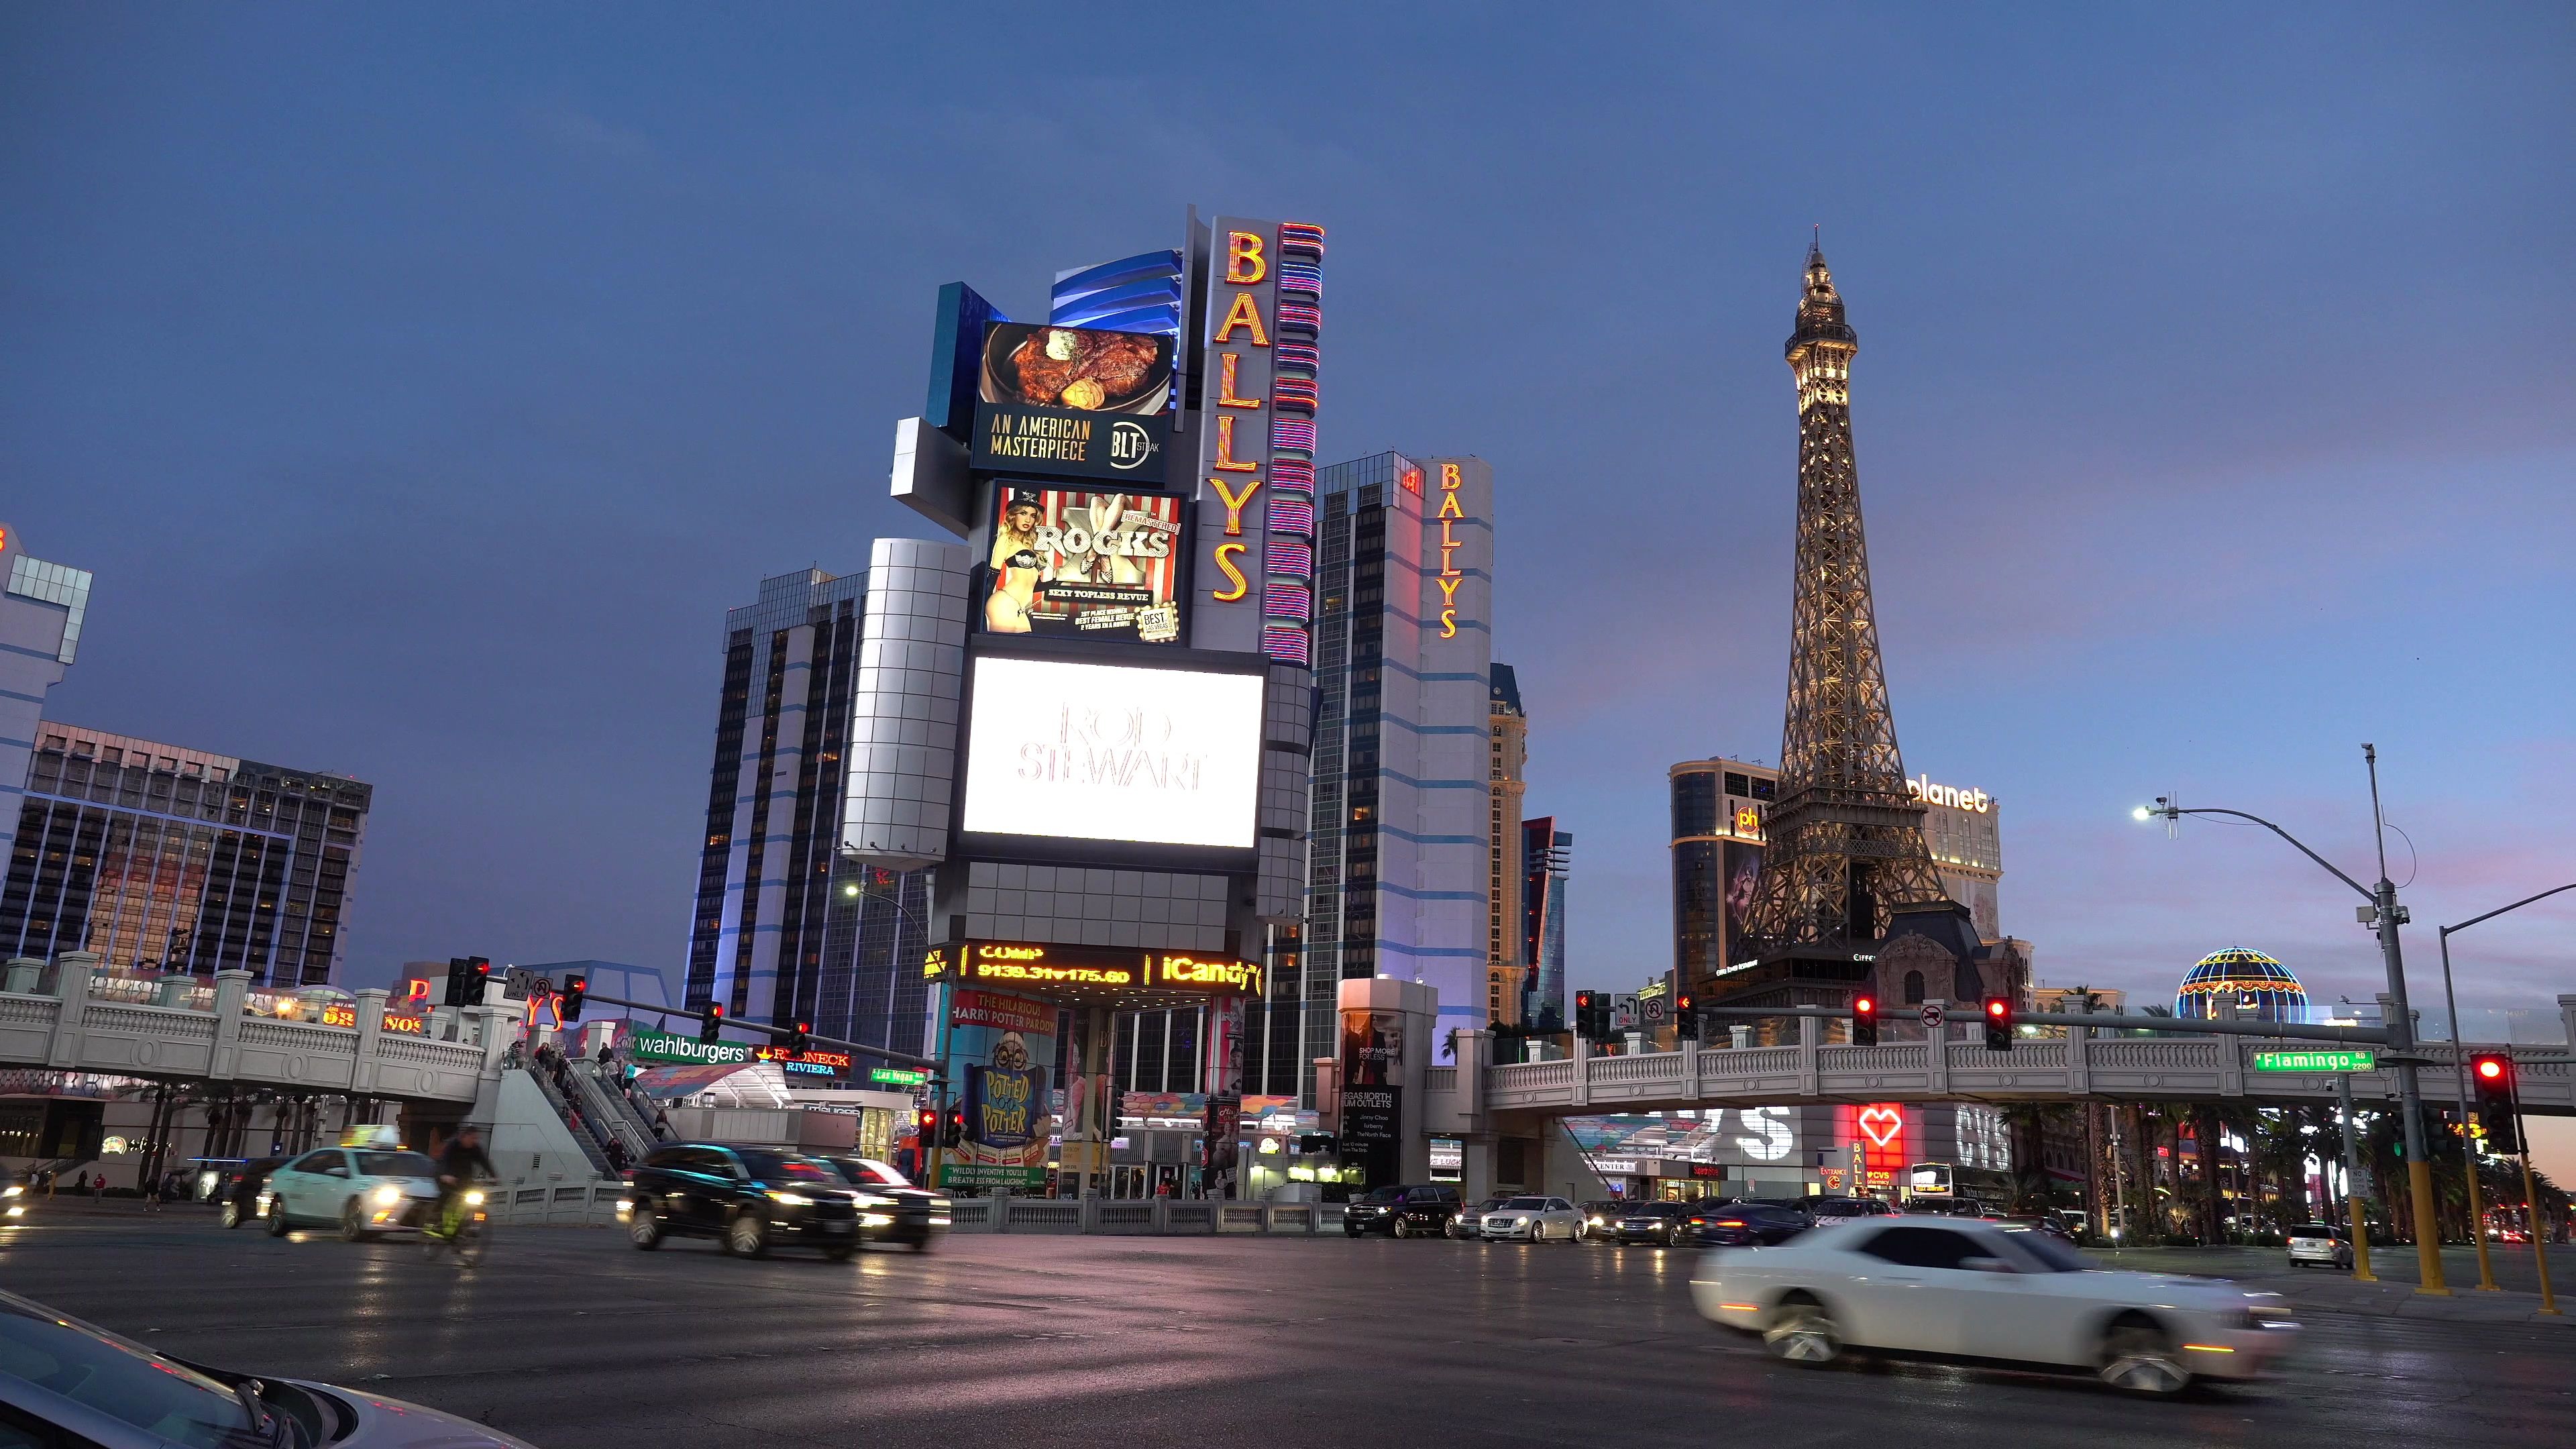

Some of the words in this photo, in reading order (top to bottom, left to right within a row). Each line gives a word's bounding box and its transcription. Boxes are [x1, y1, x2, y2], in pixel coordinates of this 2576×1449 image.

[991, 413, 1012, 433] AN
[1018, 415, 1091, 440] AMERICAN
[991, 435, 1086, 461] MASTERPIECE
[1111, 431, 1140, 458] BLT
[1136, 441, 1159, 452] STEAK
[1033, 526, 1170, 557] ROCKS
[1049, 589, 1073, 598] SEXY
[1073, 590, 1116, 600] TOPLESS
[1116, 591, 1149, 601] REVUE
[1075, 616, 1091, 625] BEST
[1091, 614, 1116, 623] FEMALE
[1085, 623, 1102, 631] YEARS
[1144, 612, 1165, 625] BEST
[1905, 773, 1988, 814] planet
[1739, 807, 1758, 828] ph
[1163, 956, 1248, 991] iCandy
[977, 994, 997, 1008] THE
[999, 998, 1041, 1017] HILARIOUS
[953, 1006, 991, 1022] HARRY
[991, 1011, 1024, 1028] POTTER
[1026, 1017, 1055, 1032] PARODY
[640, 1036, 745, 1064] wahlburgers
[774, 1049, 849, 1067] RNECK
[786, 1061, 835, 1075] RIVIERA
[2264, 1052, 2349, 1070] Flamingo
[877, 1069, 890, 1079] Las
[893, 1071, 914, 1084] Vegas
[984, 1071, 1029, 1104] POTTED
[1364, 1092, 1392, 1101] NORTH
[1357, 1100, 1393, 1108] OUTLETS
[981, 1104, 1026, 1140] POTTER
[977, 1168, 1005, 1176] INVENTIVE
[1821, 1167, 1847, 1175] ENTRANCE
[1874, 1171, 1890, 1179] CVS
